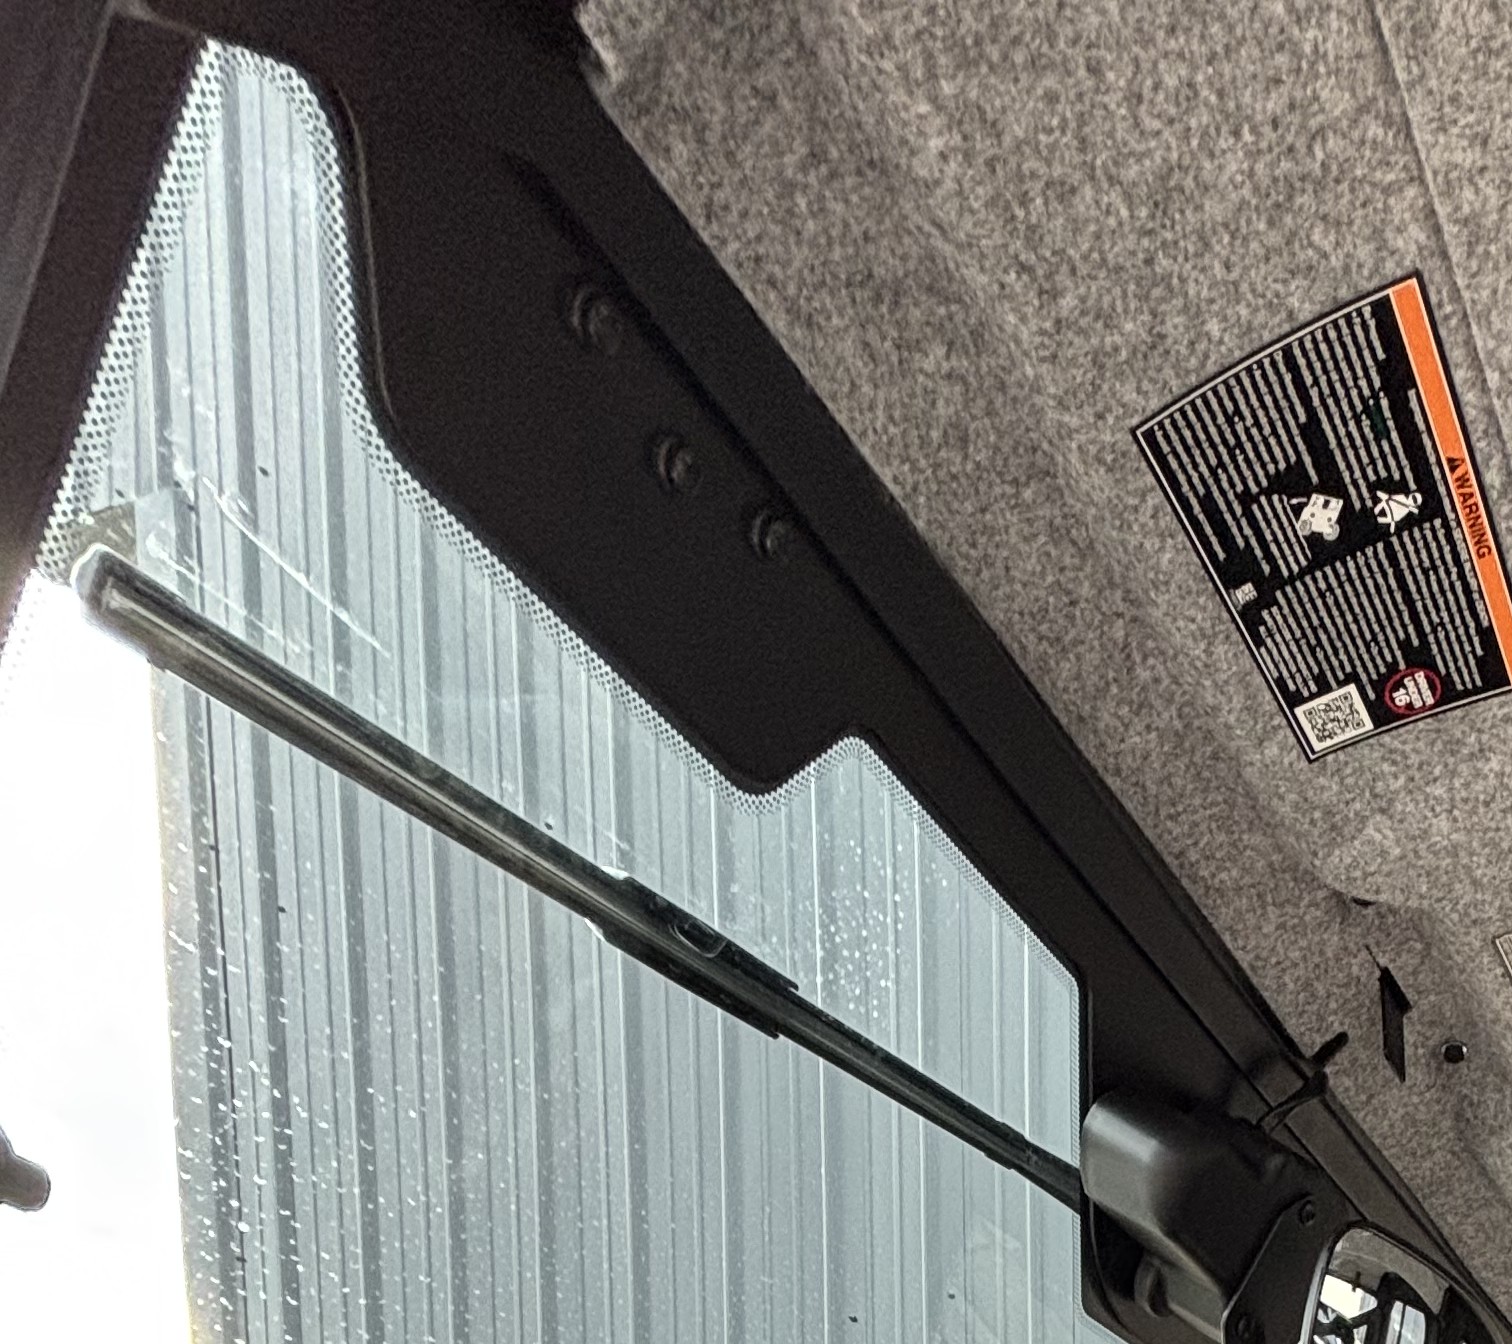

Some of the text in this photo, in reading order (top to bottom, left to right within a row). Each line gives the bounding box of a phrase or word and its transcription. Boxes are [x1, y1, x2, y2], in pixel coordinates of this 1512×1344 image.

[1455, 473, 1491, 560] WARNING
[1392, 688, 1410, 707] 16
[1404, 676, 1423, 709] UNDER
[1414, 670, 1435, 707] DRIVER
